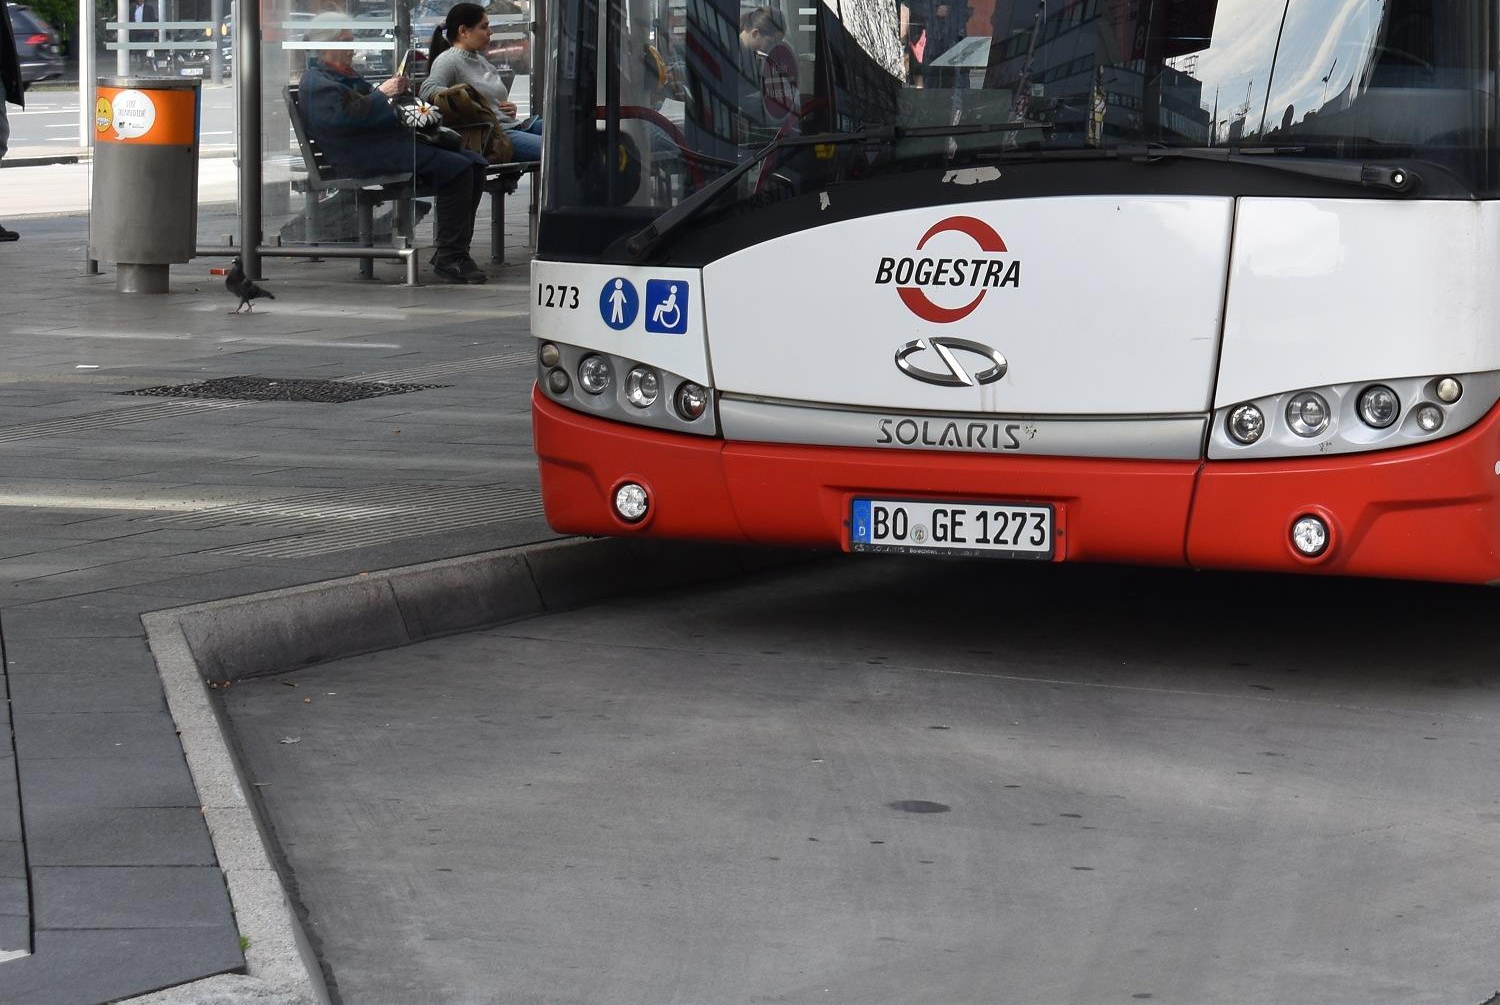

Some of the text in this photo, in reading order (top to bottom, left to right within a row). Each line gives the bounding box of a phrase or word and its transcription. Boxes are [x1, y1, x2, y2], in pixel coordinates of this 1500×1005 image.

[874, 257, 1021, 288] BOGESTRA
[537, 283, 580, 309] 1273
[876, 418, 1021, 449] SOLARIS
[858, 526, 866, 536] D
[873, 506, 1046, 546] BO GE 1273
